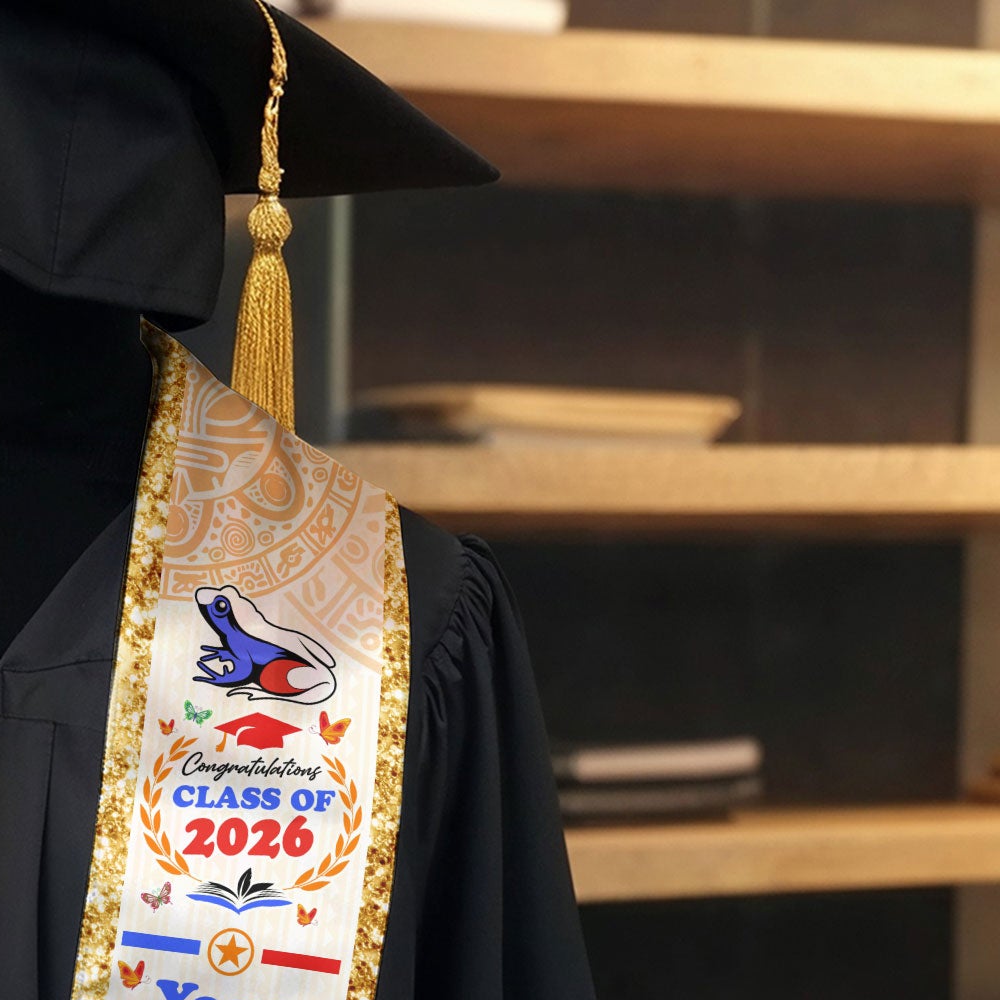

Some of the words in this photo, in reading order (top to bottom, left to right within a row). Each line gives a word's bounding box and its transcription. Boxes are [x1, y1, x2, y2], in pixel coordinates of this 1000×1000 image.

[181, 751, 322, 781] Congratulations
[172, 784, 281, 811] CLASS
[290, 787, 336, 813] OF
[182, 815, 314, 859] 2026
